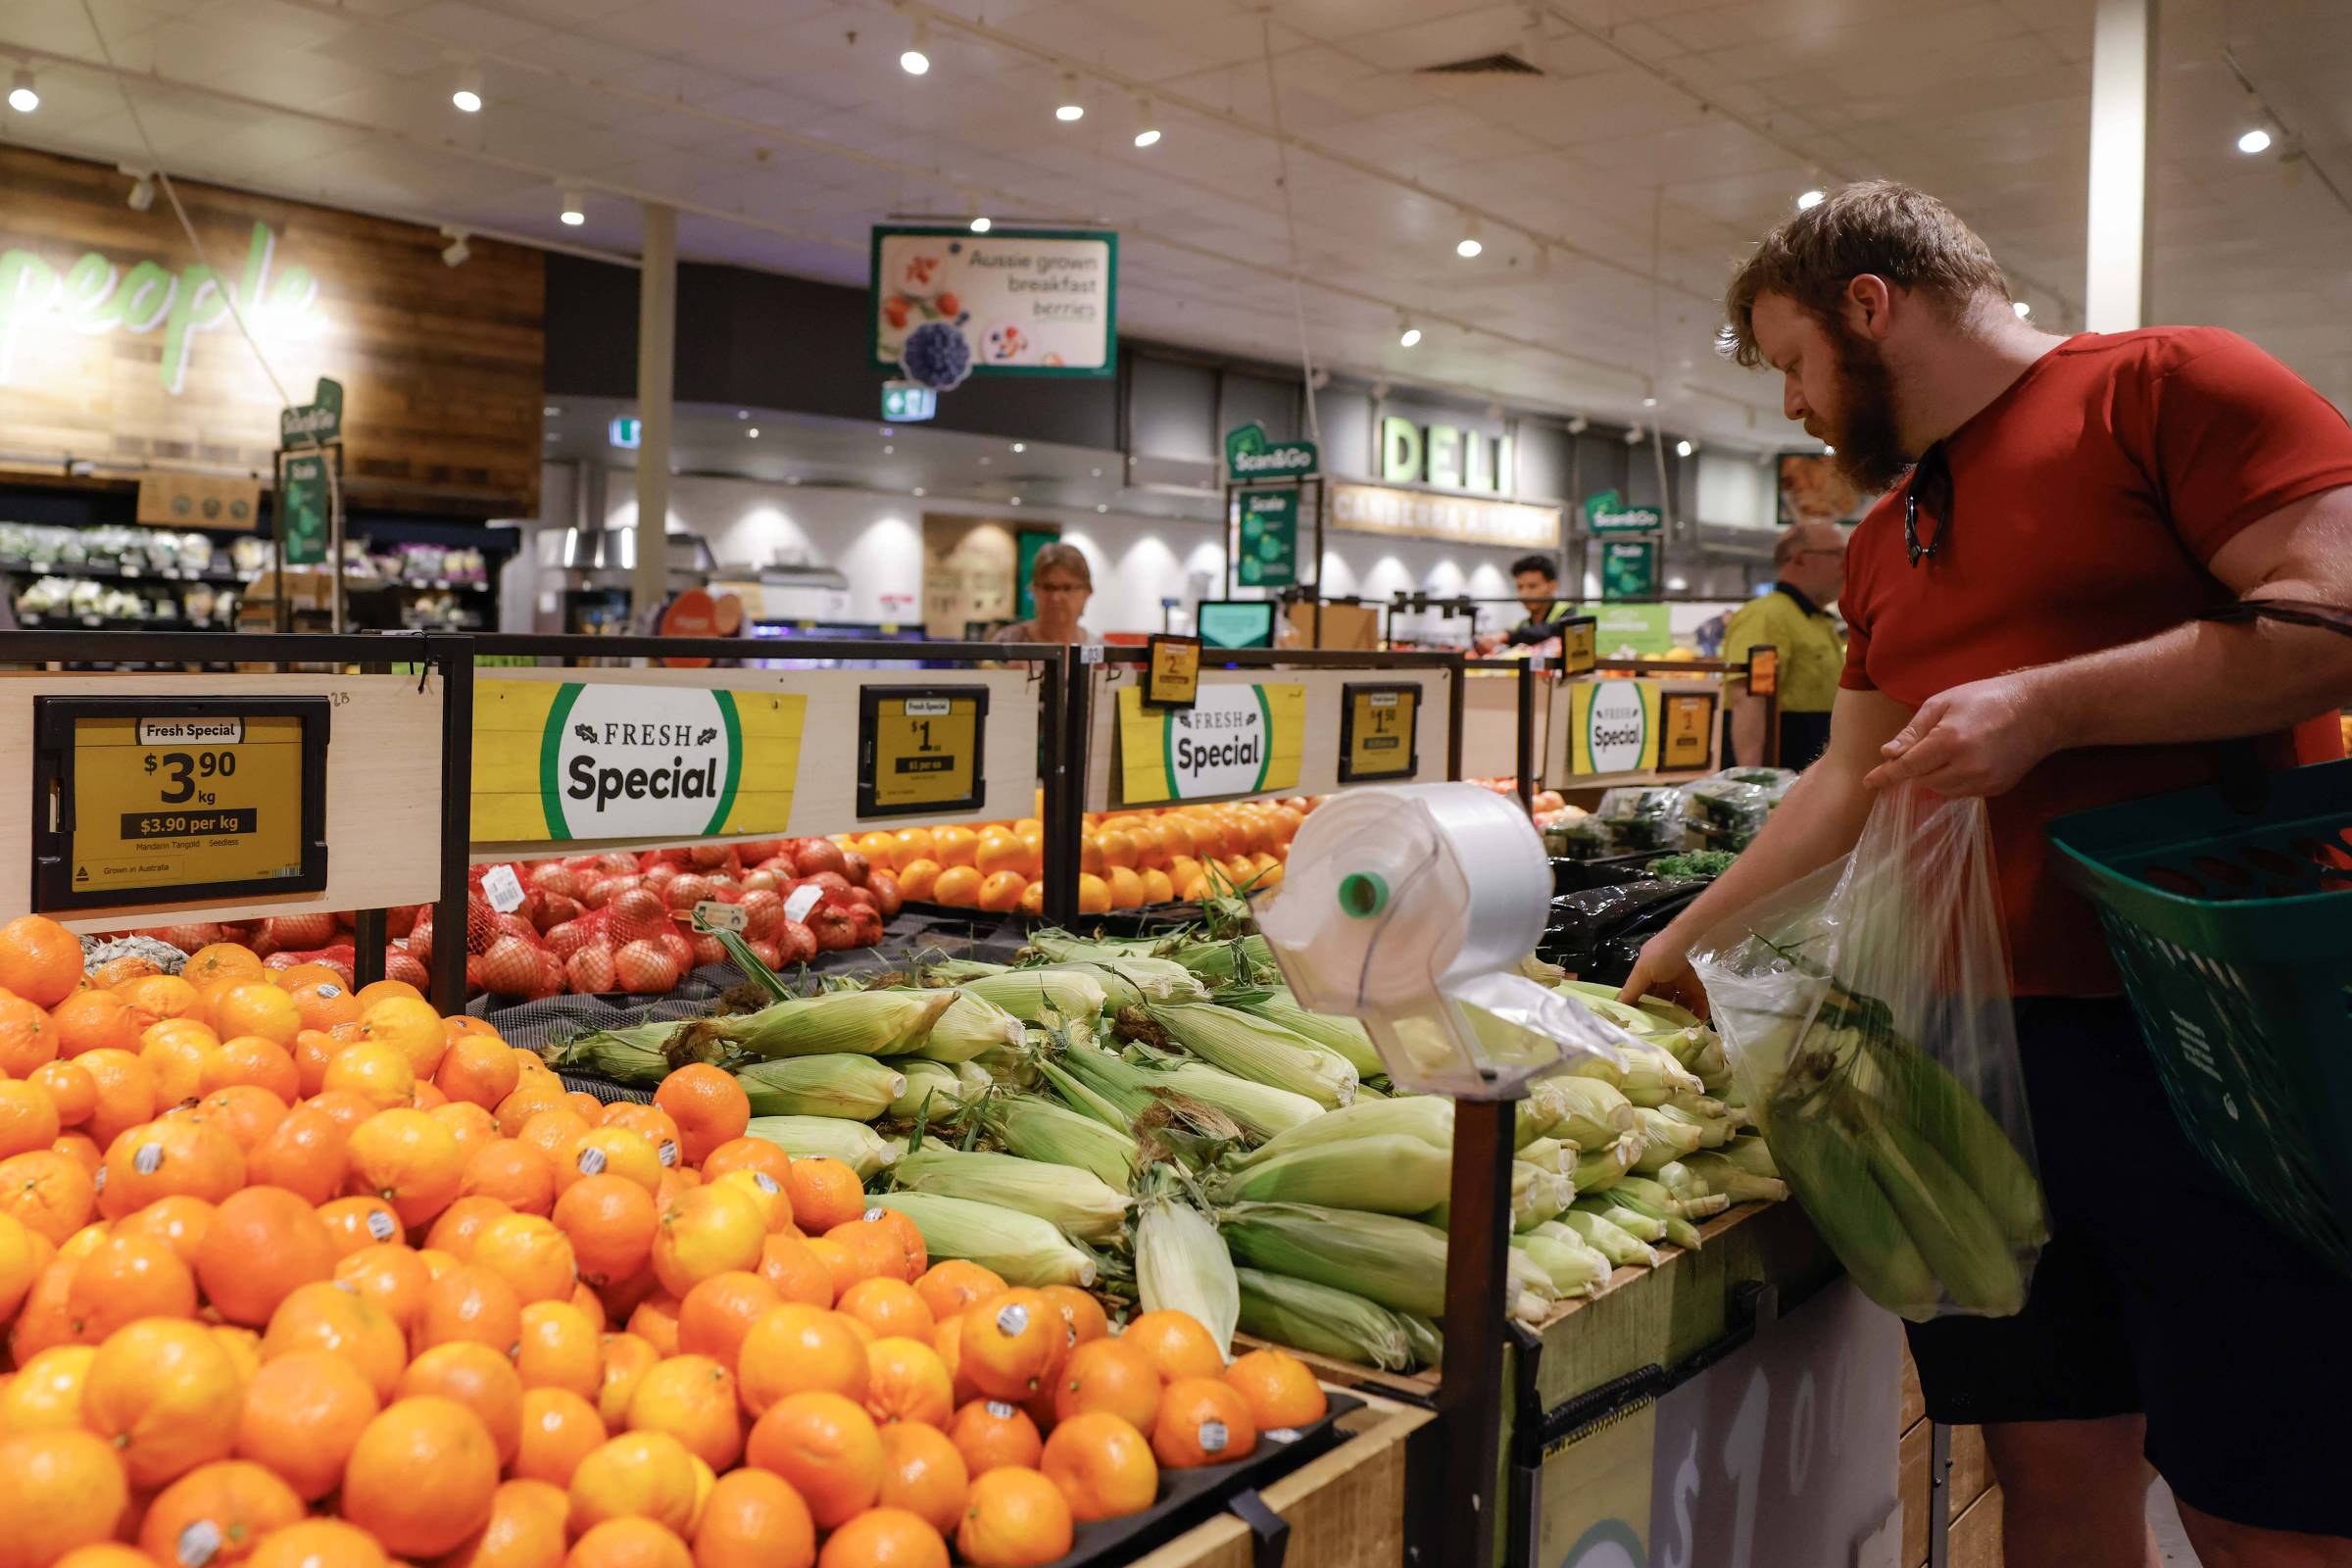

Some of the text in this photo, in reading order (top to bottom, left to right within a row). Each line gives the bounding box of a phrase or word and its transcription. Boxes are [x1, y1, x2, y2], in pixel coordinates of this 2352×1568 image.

[969, 250, 1097, 274] Aussie grown
[1007, 274, 1096, 292] breakfast
[0, 220, 328, 396] people
[1033, 300, 1096, 318] berries
[1382, 416, 1514, 499] DELI
[1195, 711, 1243, 729] FRESH
[146, 723, 235, 740] Fresh Special
[605, 723, 692, 747] FRESH
[1594, 719, 1640, 753] Special
[1178, 734, 1258, 777] Special
[566, 755, 716, 812] Special
[198, 790, 216, 806] kg
[140, 815, 239, 834] $3.90 per kg
[135, 838, 239, 852] Mandarin Tangold Seedless
[103, 865, 126, 875] Grown
[138, 863, 169, 873] Australia
